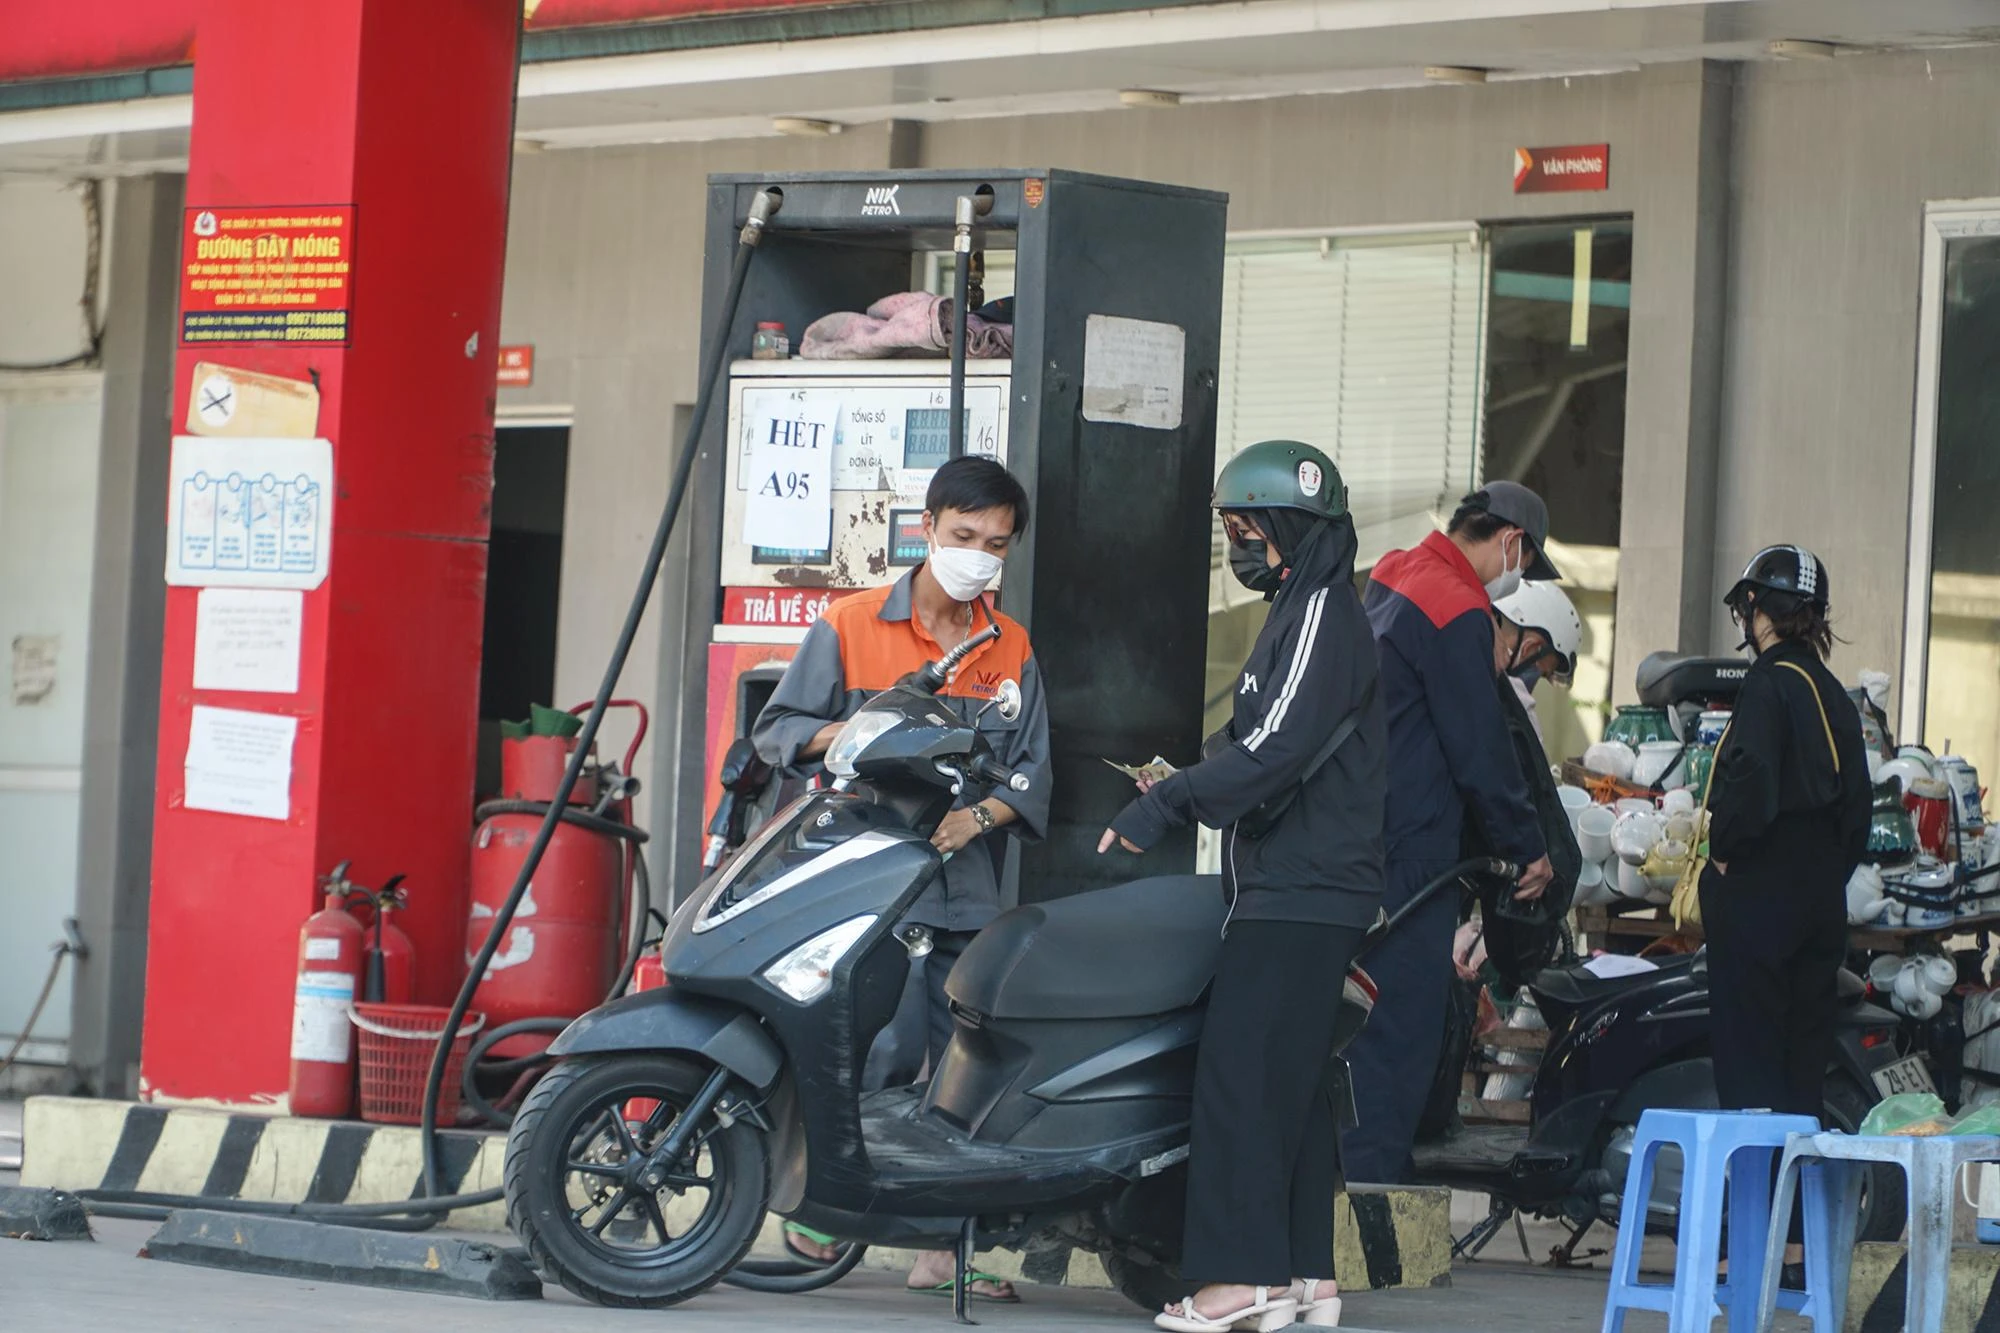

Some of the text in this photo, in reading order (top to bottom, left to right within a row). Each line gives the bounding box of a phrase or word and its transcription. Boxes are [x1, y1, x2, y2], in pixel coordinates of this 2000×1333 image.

[1543, 155, 1602, 175] VĂN PHÒNG
[866, 184, 900, 215] NIK
[861, 205, 892, 215] PETRO
[197, 233, 340, 259] ĐƯỜNG DÂY NÓNG
[929, 391, 944, 404] 16
[852, 408, 886, 423] TỔNG SỐ
[768, 412, 825, 449] HẾT
[861, 433, 873, 445] LÍT
[977, 426, 994, 450] 16
[849, 457, 866, 467] ĐƠN
[758, 471, 810, 500] A95
[744, 591, 830, 624] TRẢ VỀ SỐ
[1716, 668, 1748, 679] HON
